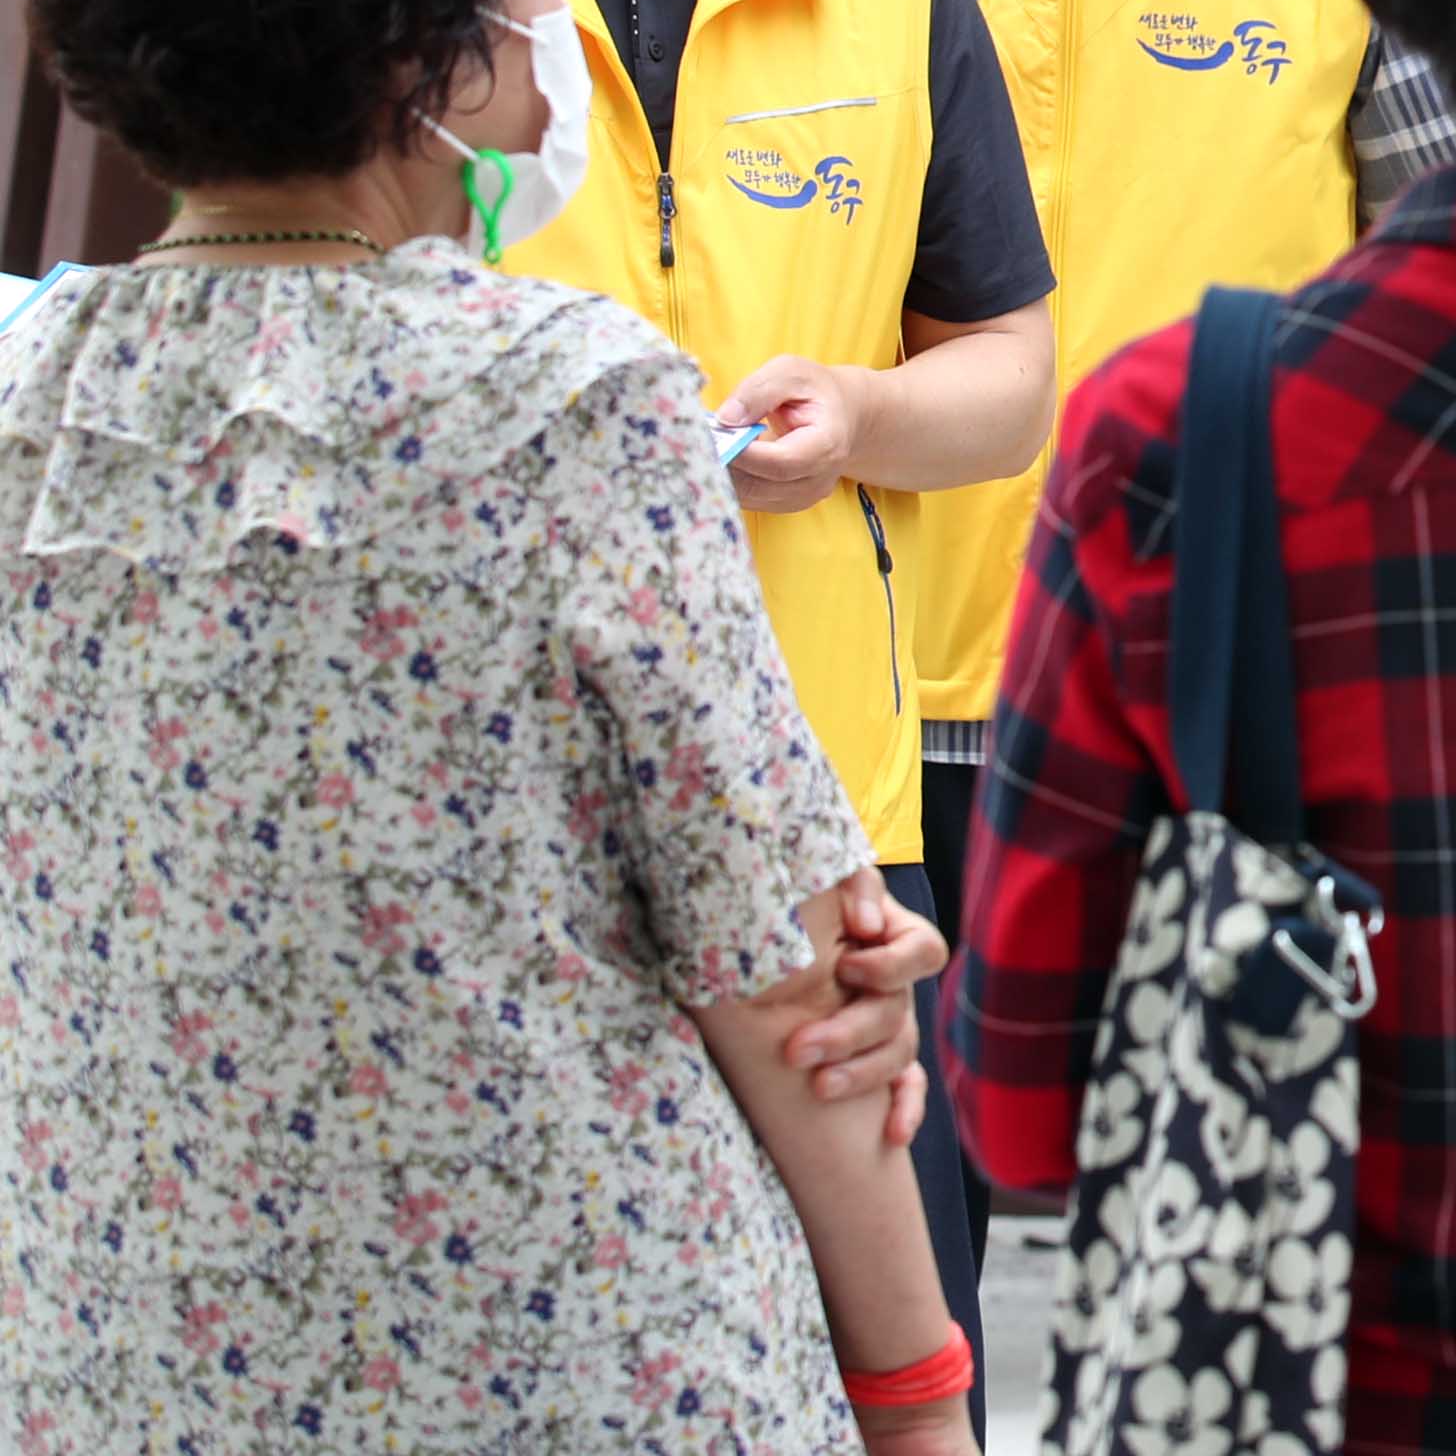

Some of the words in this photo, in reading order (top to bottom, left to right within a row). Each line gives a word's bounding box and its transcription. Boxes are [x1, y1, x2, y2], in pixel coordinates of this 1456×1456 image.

[1233, 20, 1292, 85] 동구
[726, 149, 754, 166] 새로운
[756, 150, 782, 168] 변화
[815, 156, 863, 225] 동구
